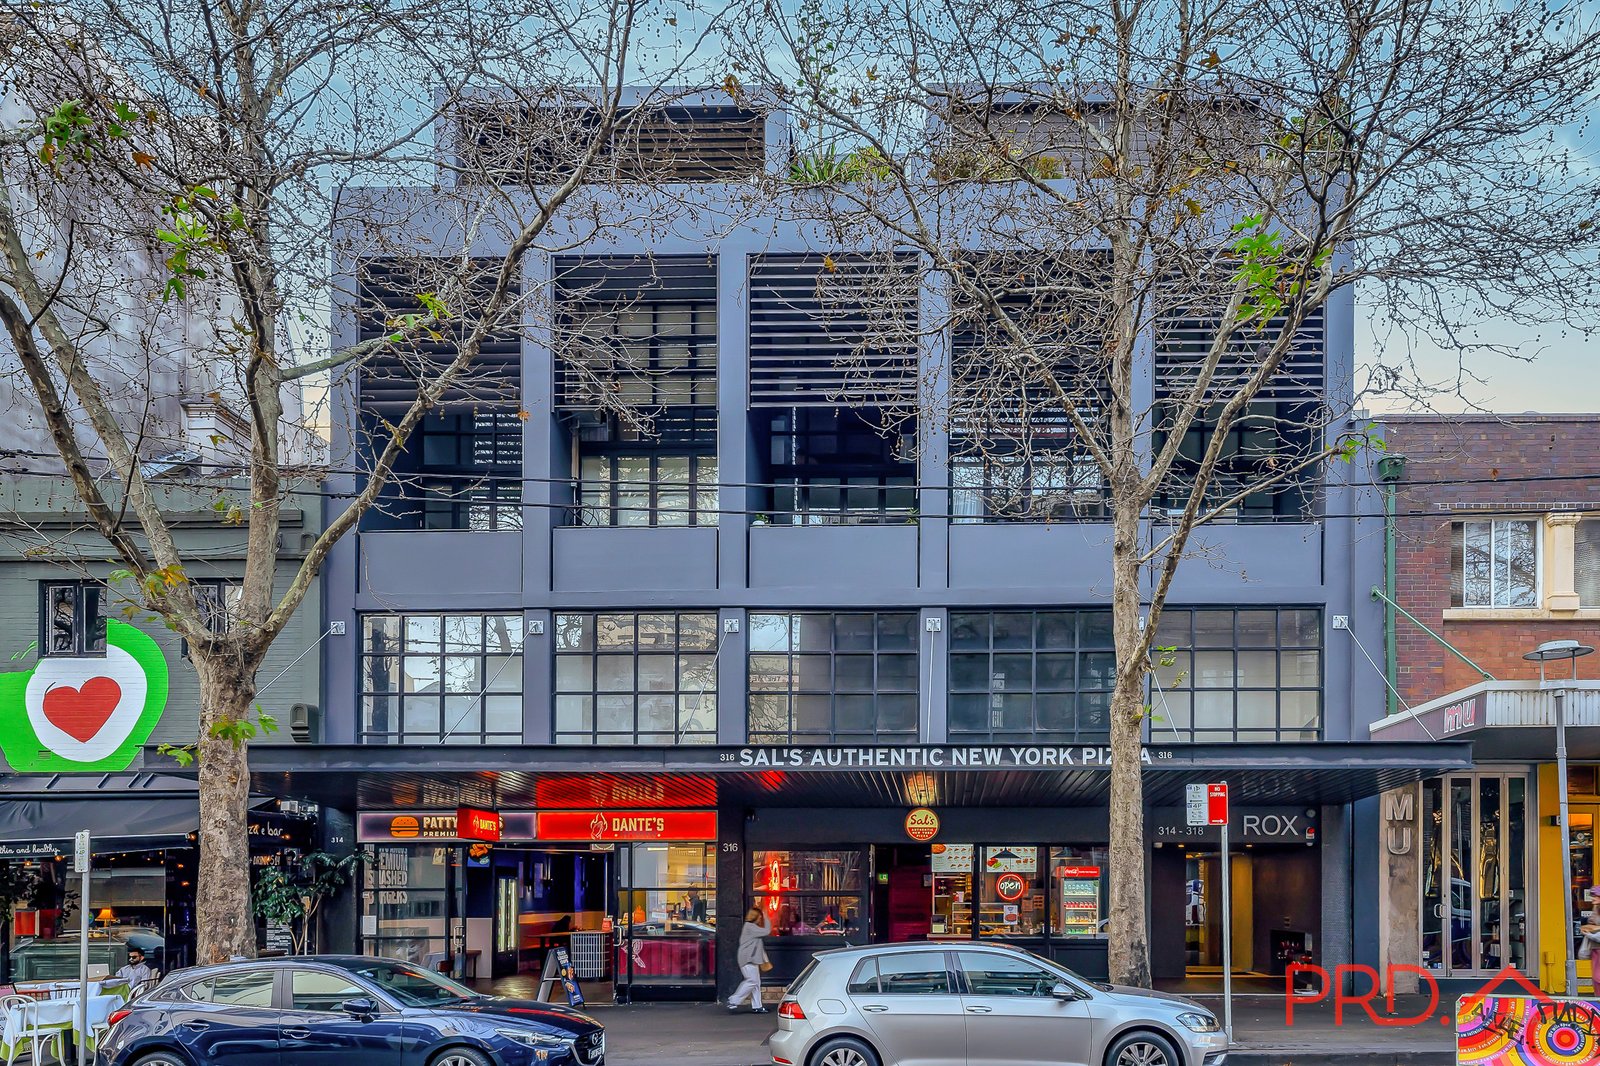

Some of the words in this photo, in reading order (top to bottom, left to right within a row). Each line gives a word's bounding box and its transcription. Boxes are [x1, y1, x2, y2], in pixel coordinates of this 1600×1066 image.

[1444, 699, 1476, 734] mu
[719, 753, 735, 761] 316
[739, 748, 803, 767] SAL'S
[810, 748, 944, 767] AUTHENTIC
[951, 747, 1003, 766] NEW
[1009, 747, 1075, 766] YORK
[1158, 751, 1173, 760] 316
[479, 818, 497, 832] DANTE'S
[612, 817, 665, 832] DANTE'S
[910, 814, 935, 826] Sal's
[1242, 815, 1299, 837] ROX
[267, 821, 283, 836] bar
[1158, 826, 1177, 836] 314
[1186, 826, 1204, 836] 318
[15, 845, 31, 854] and
[722, 843, 738, 852] 316
[999, 881, 1021, 895] open
